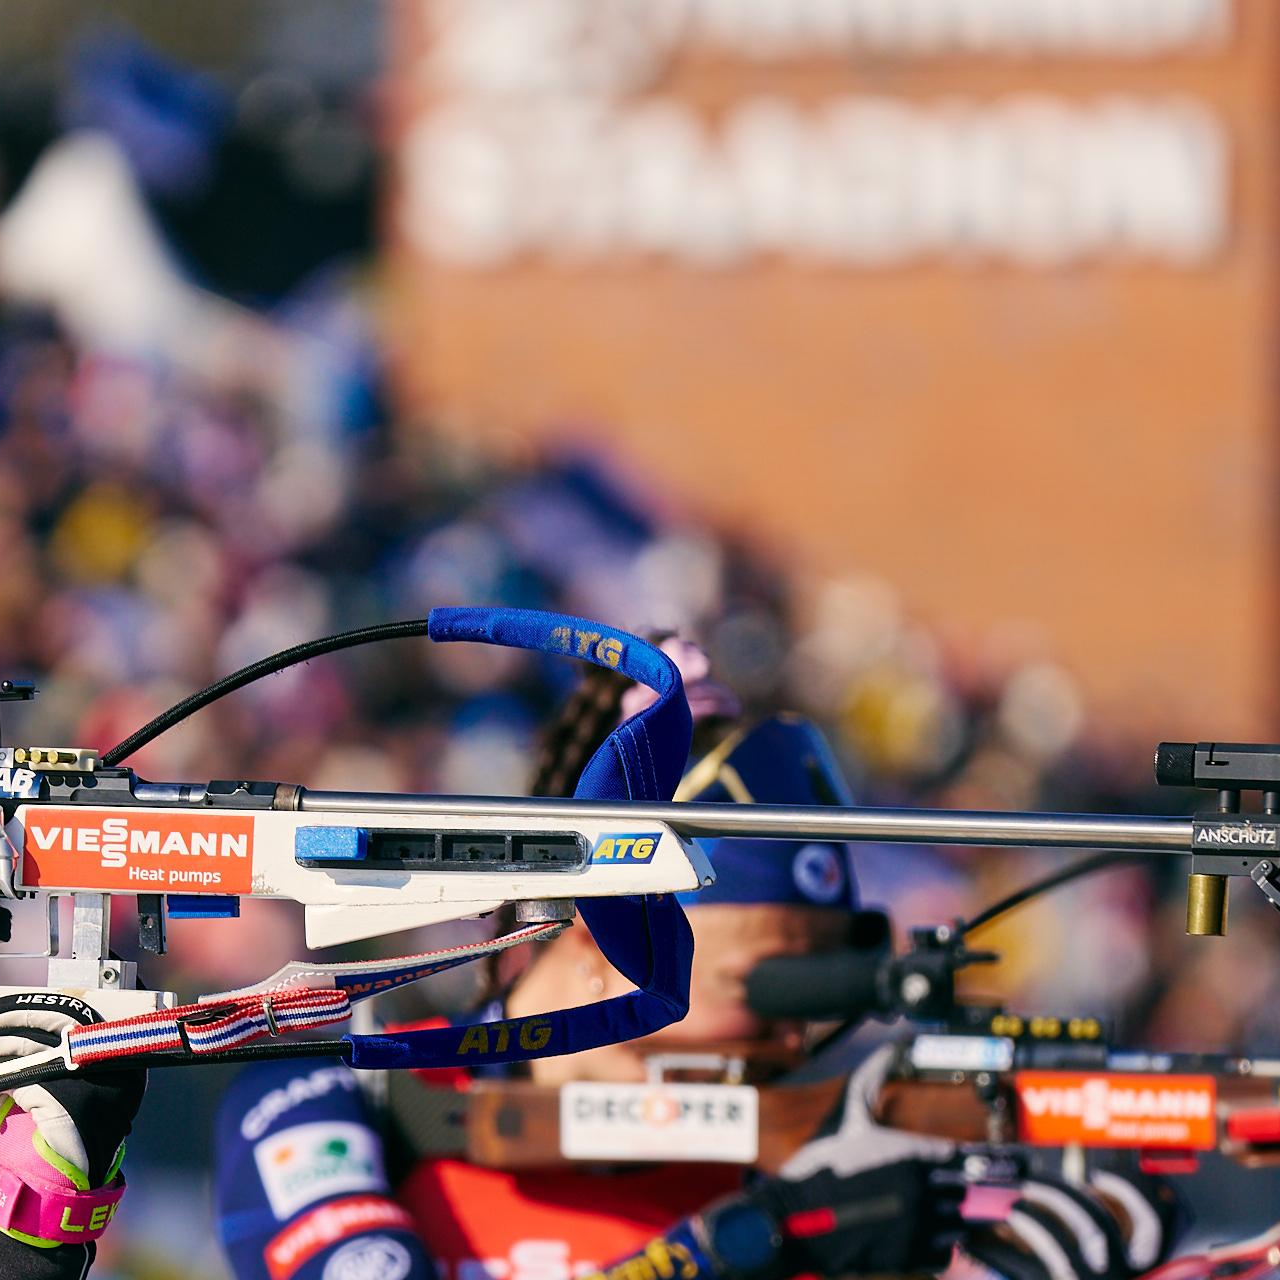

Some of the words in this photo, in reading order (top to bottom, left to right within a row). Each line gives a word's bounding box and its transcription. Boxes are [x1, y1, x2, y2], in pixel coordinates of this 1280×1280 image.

[30, 818, 248, 868] VIESSMANN
[593, 838, 655, 860] ATG
[129, 867, 165, 881] Heat
[169, 869, 222, 886] pumps
[16, 994, 94, 1024] HESTRA
[457, 1018, 553, 1055] ATG
[60, 1199, 121, 1233] LEK
